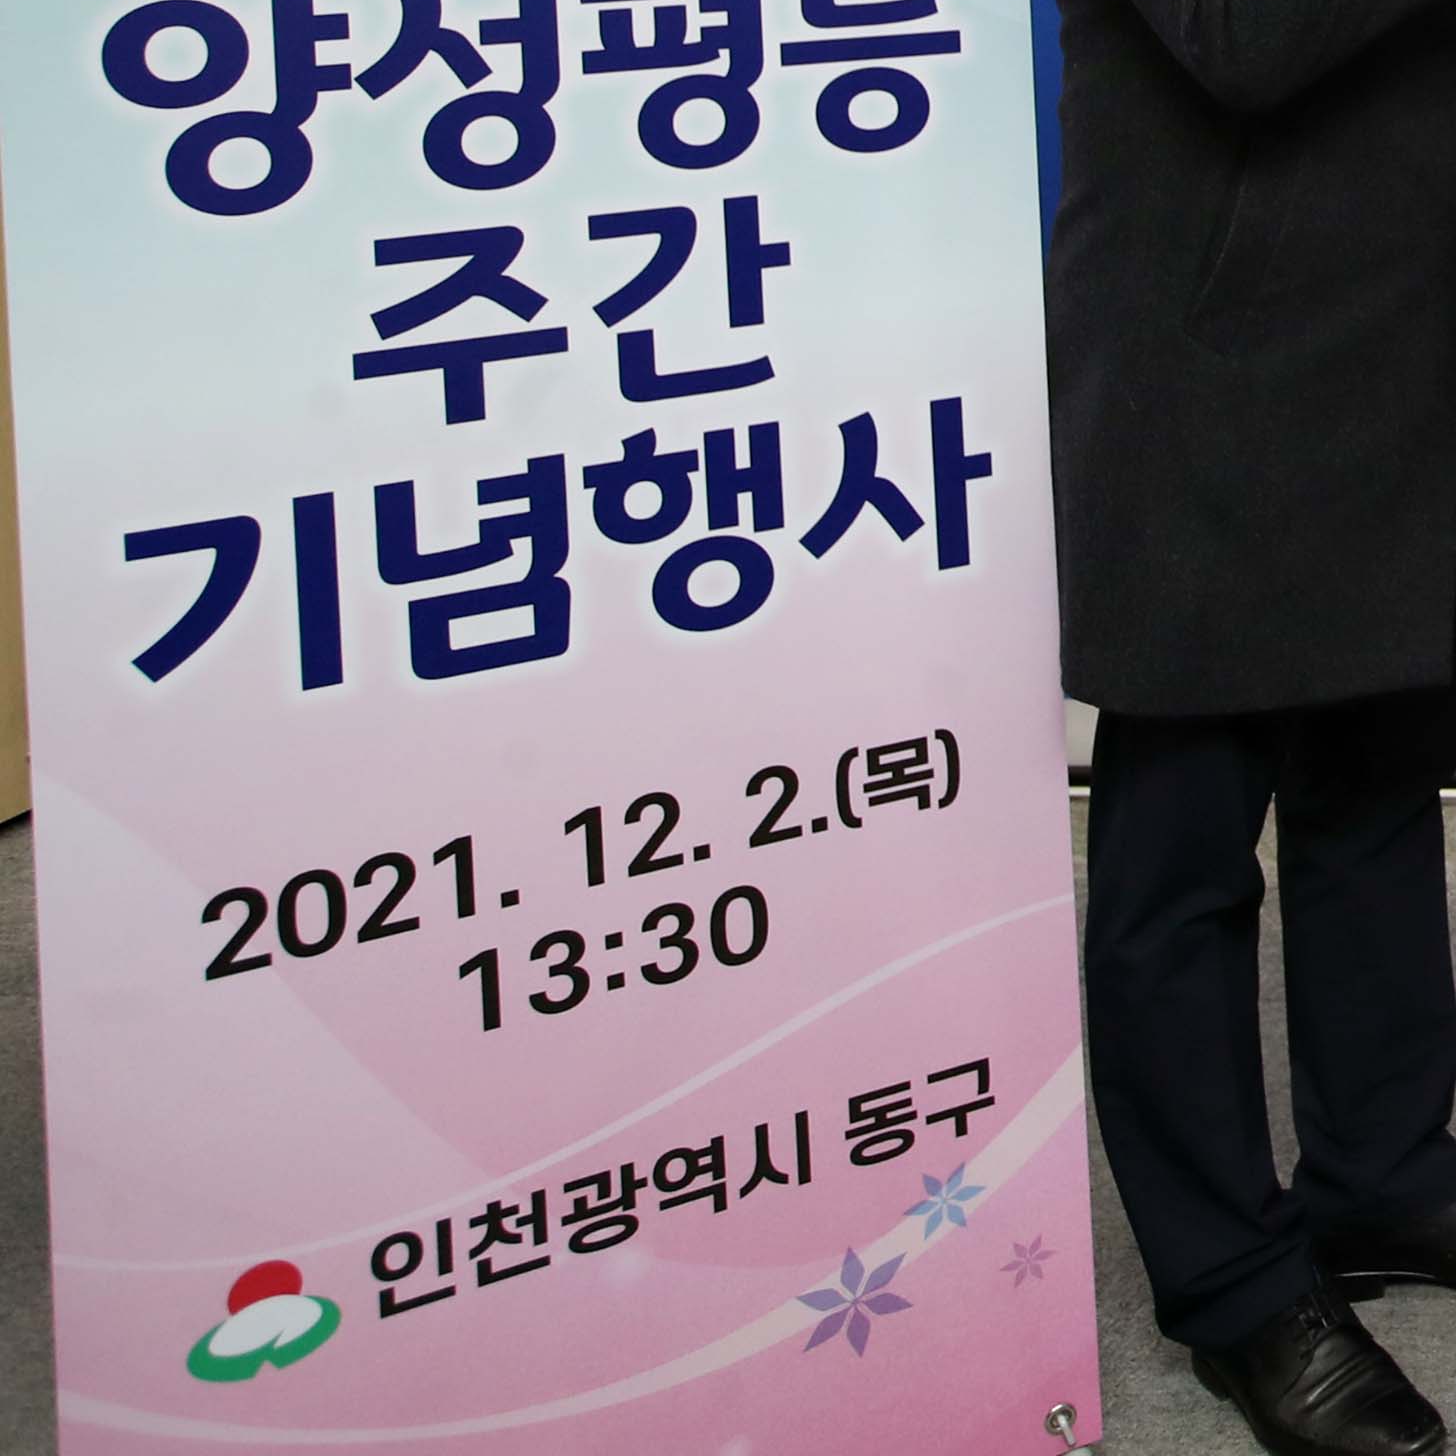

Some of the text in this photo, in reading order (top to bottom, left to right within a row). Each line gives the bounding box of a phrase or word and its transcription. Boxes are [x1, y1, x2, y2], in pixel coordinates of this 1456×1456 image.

[351, 194, 792, 427] 주간
[123, 396, 994, 692] 기념행사
[200, 727, 961, 982] 2021. 12. 2.(목)
[458, 884, 771, 1033] 13:30
[369, 1056, 998, 1320] 인천광역시 동구
